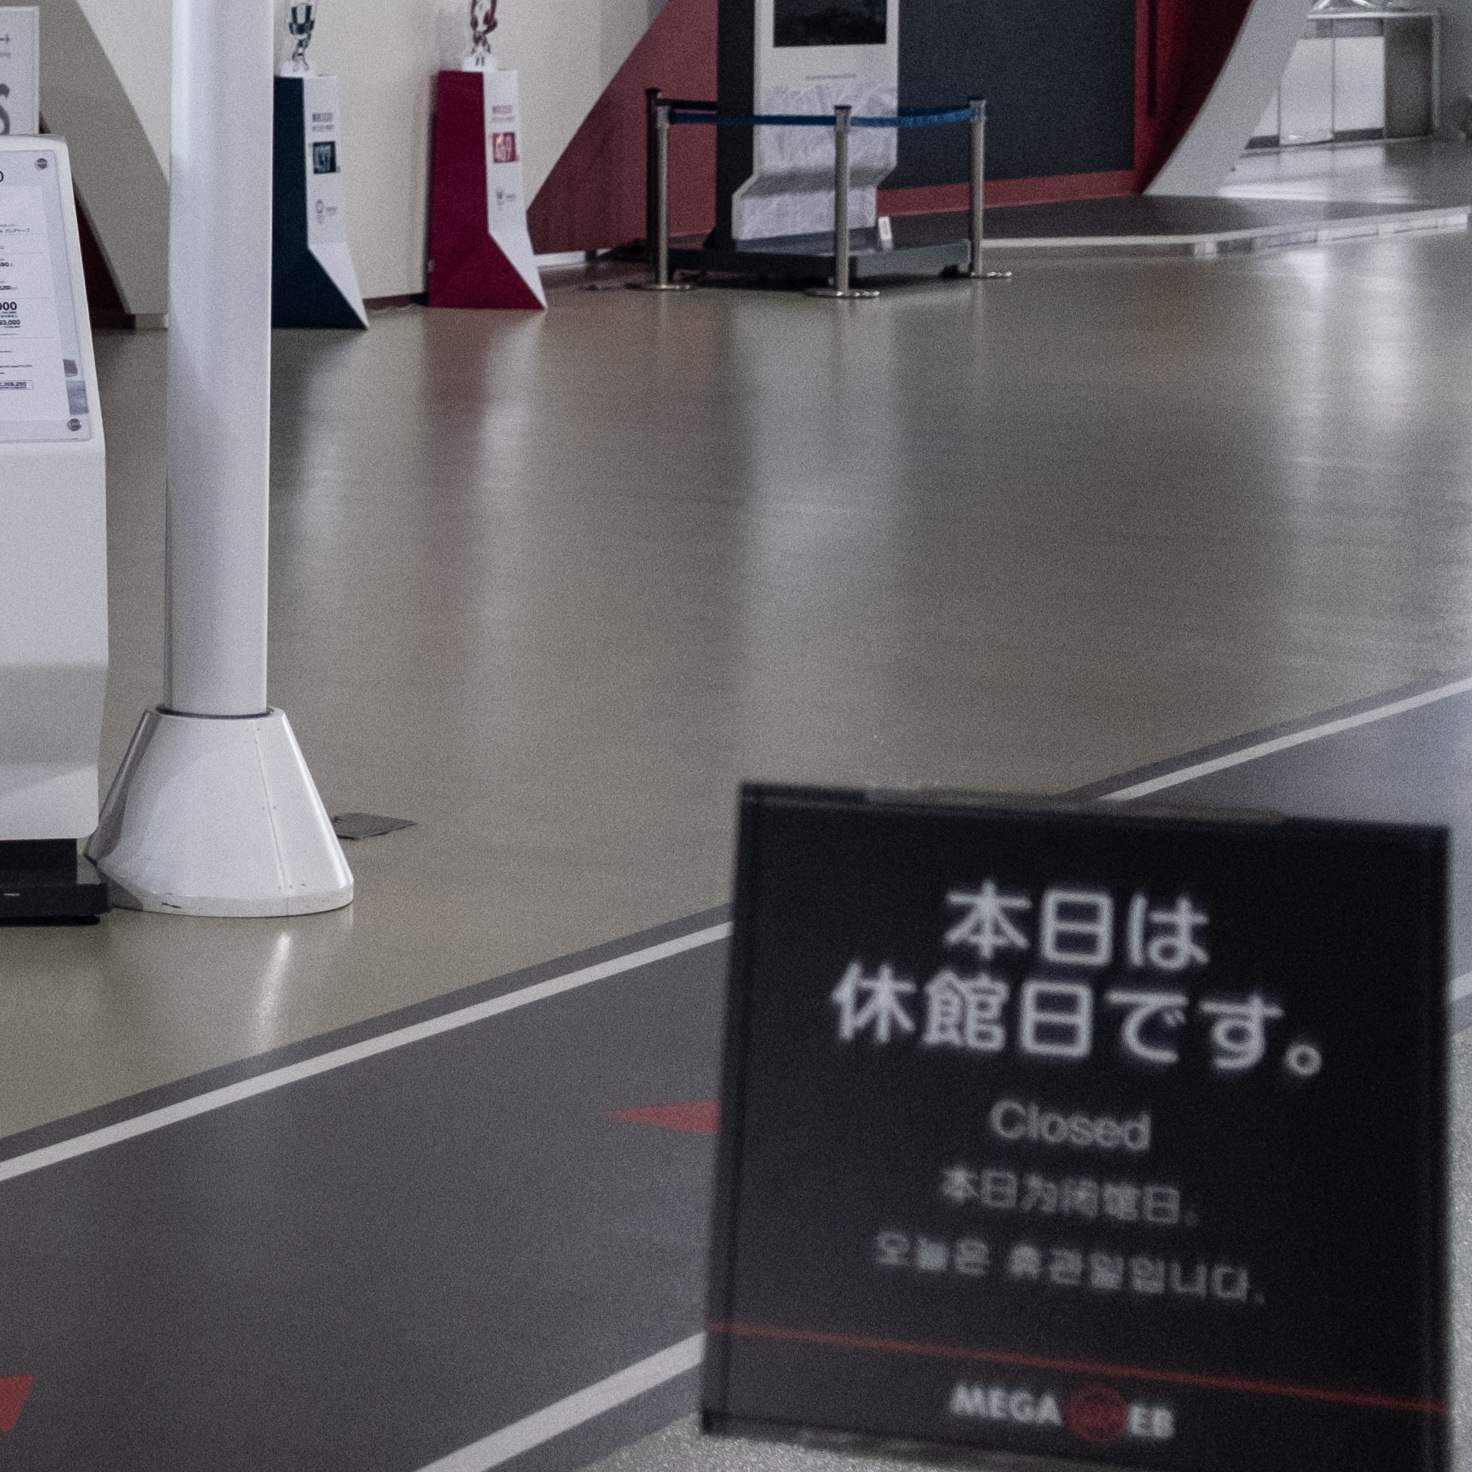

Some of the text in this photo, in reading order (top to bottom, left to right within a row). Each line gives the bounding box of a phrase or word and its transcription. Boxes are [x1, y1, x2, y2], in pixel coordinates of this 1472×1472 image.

[942, 880, 1210, 971] 本日は
[831, 961, 1323, 1077] 休館日です。
[988, 1099, 1152, 1152] Closed
[950, 1384, 1062, 1427] MEGA
